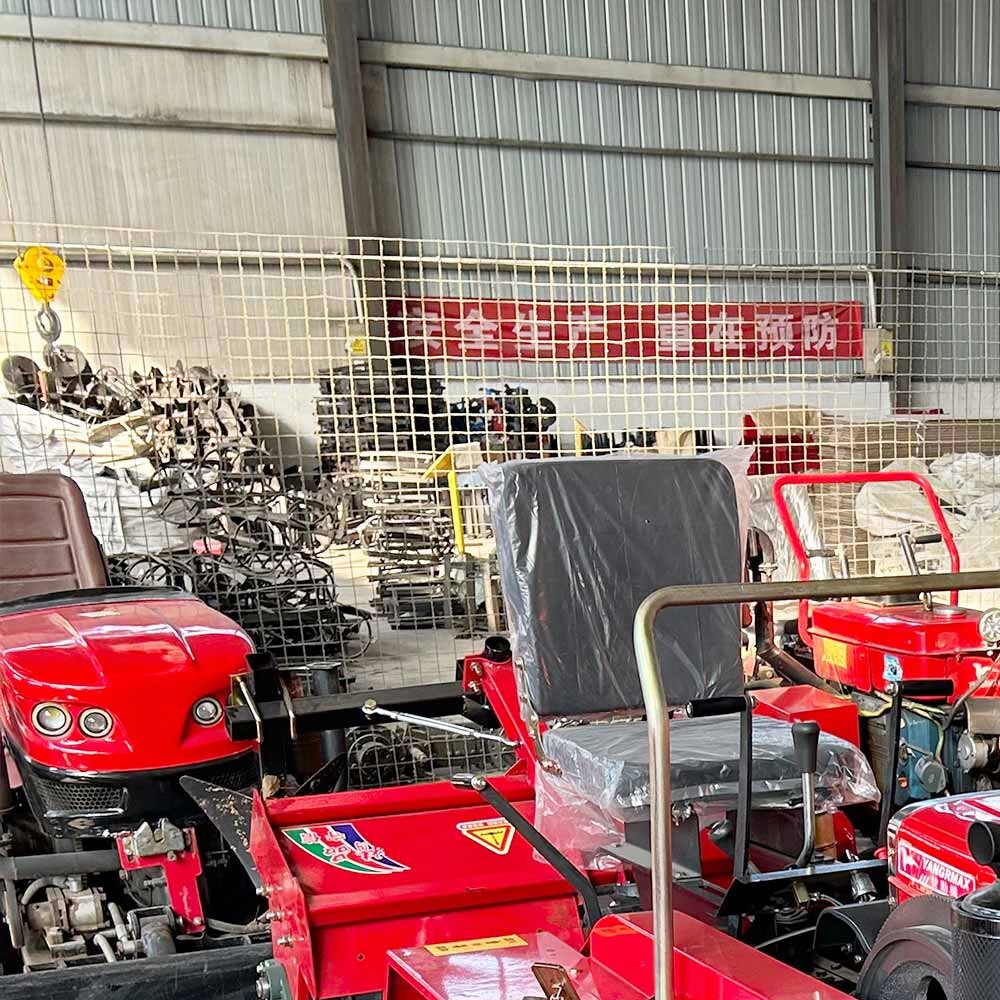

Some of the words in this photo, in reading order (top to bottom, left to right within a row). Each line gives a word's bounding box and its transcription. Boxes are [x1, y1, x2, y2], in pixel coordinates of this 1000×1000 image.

[657, 311, 840, 352] 重在预防
[922, 857, 970, 891] YANGRMAX
